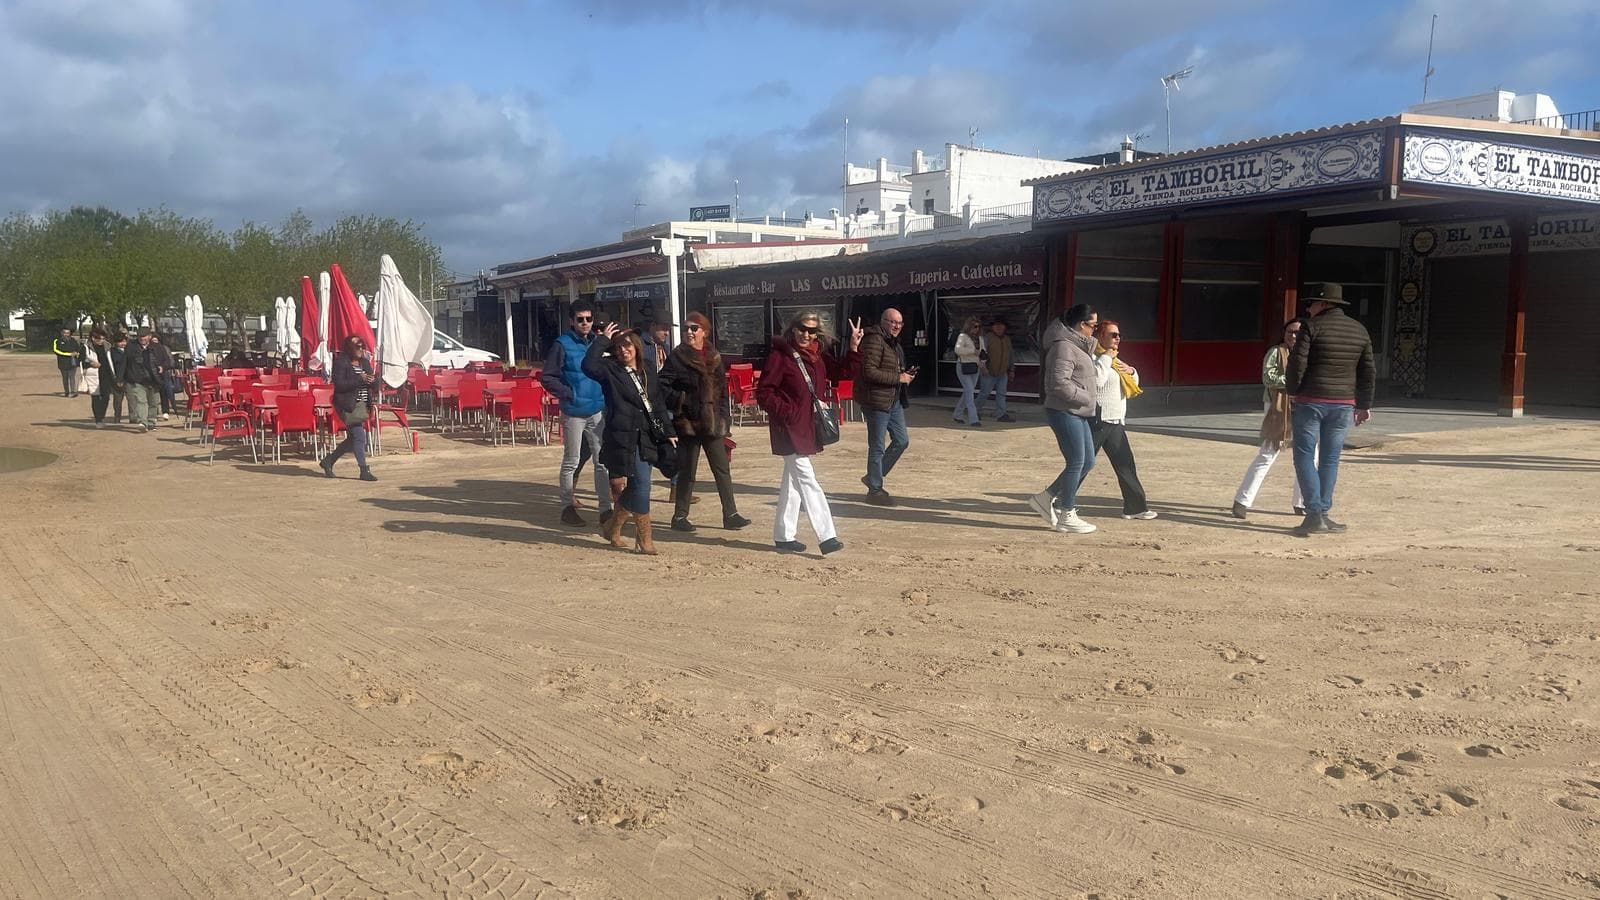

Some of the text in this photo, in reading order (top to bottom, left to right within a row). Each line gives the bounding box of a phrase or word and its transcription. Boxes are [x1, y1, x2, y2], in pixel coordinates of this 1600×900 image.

[1494, 152, 1520, 174] EL
[1109, 159, 1263, 198] EL TAMBORIL
[1528, 178, 1592, 194] TIENDA ROCIERA
[1142, 185, 1219, 202] TIENDA ROCIERA
[1446, 227, 1471, 242] EL
[713, 283, 755, 297] Restaurante
[761, 281, 776, 294] Bar
[790, 279, 811, 292] LAS
[821, 272, 889, 290] CARRETAS
